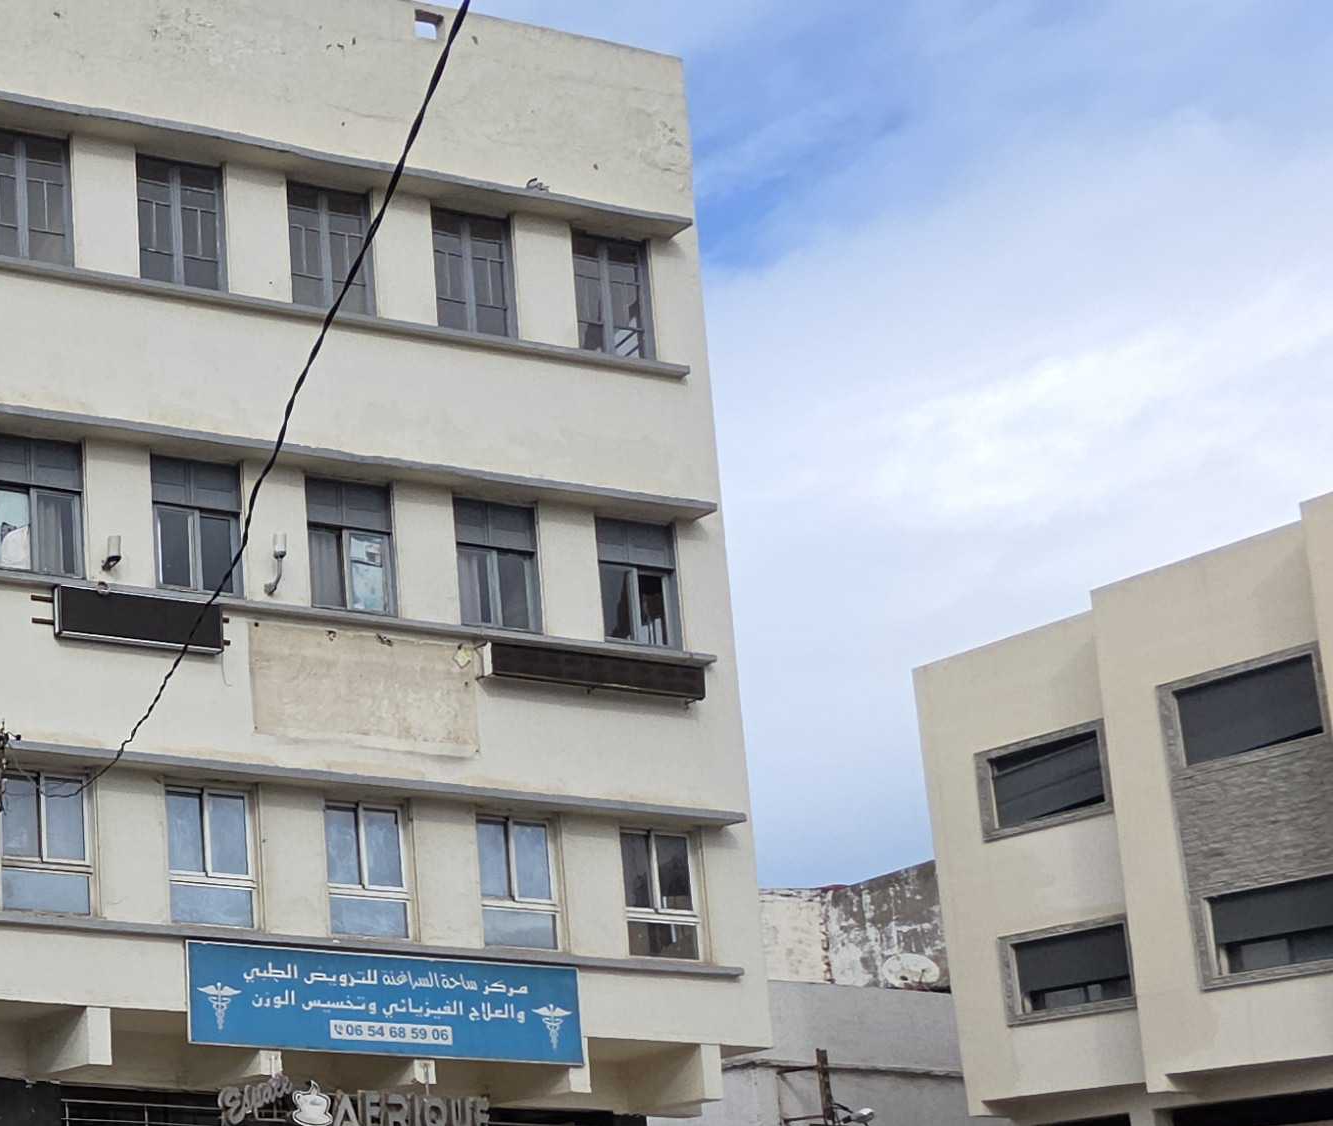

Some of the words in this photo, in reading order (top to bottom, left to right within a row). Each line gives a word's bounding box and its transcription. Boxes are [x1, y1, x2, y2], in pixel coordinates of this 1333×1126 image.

[243, 962, 298, 983] الطبي
[303, 965, 379, 987] للترويض
[441, 973, 478, 991] ساحة
[482, 980, 529, 997] مركز
[252, 989, 296, 1009] الوزن
[301, 994, 377, 1014] وتخسيس
[382, 997, 464, 1019] الفيزيائي
[468, 1002, 526, 1023] والعلاج
[345, 1023, 363, 1037] 06
[367, 1025, 385, 1038] 54
[389, 1026, 406, 1039] 68
[410, 1027, 428, 1040] 59
[431, 1028, 449, 1041] 06
